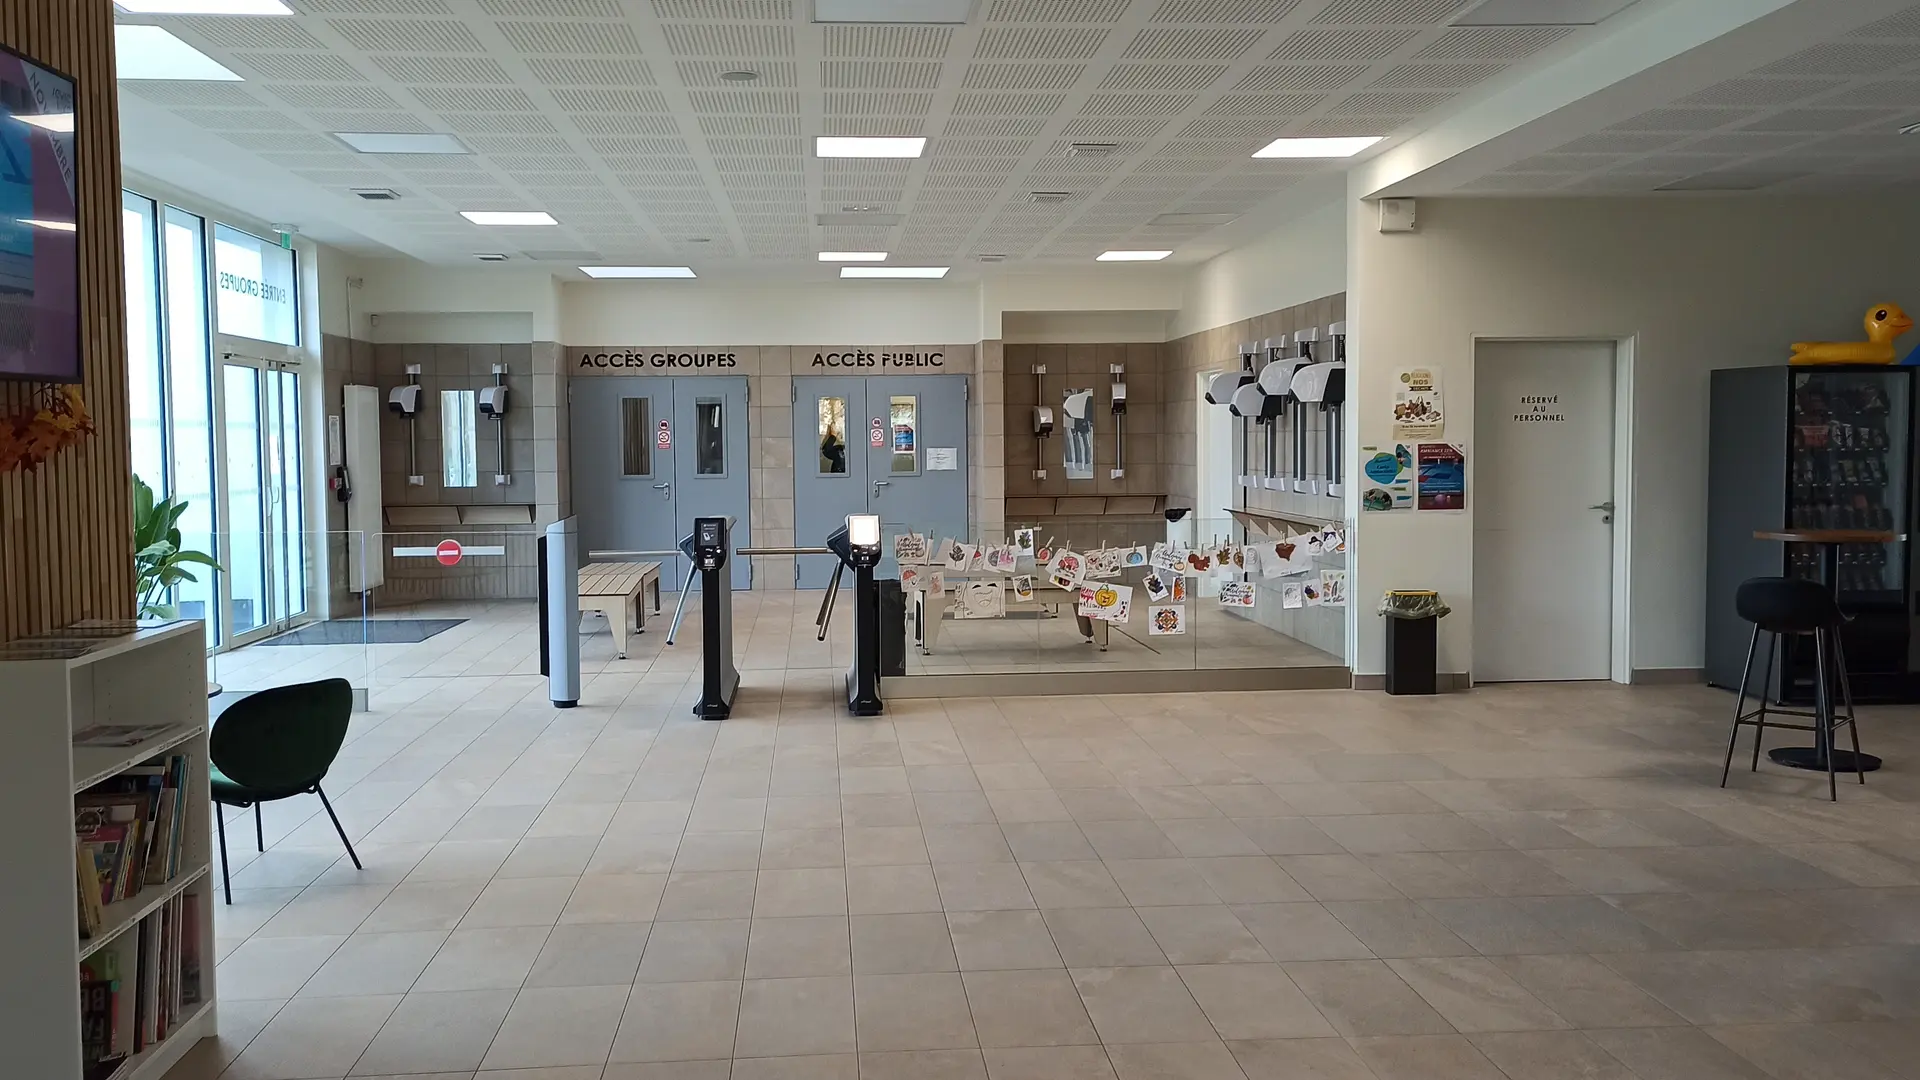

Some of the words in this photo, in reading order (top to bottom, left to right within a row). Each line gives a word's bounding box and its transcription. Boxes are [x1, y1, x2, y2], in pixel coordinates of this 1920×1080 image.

[580, 350, 644, 368] ACCÈS
[650, 354, 736, 368] GROUPES
[812, 350, 875, 367] ACCÈS
[882, 353, 944, 367] PUBLIC
[1521, 394, 1558, 404] RÉSERVÉ
